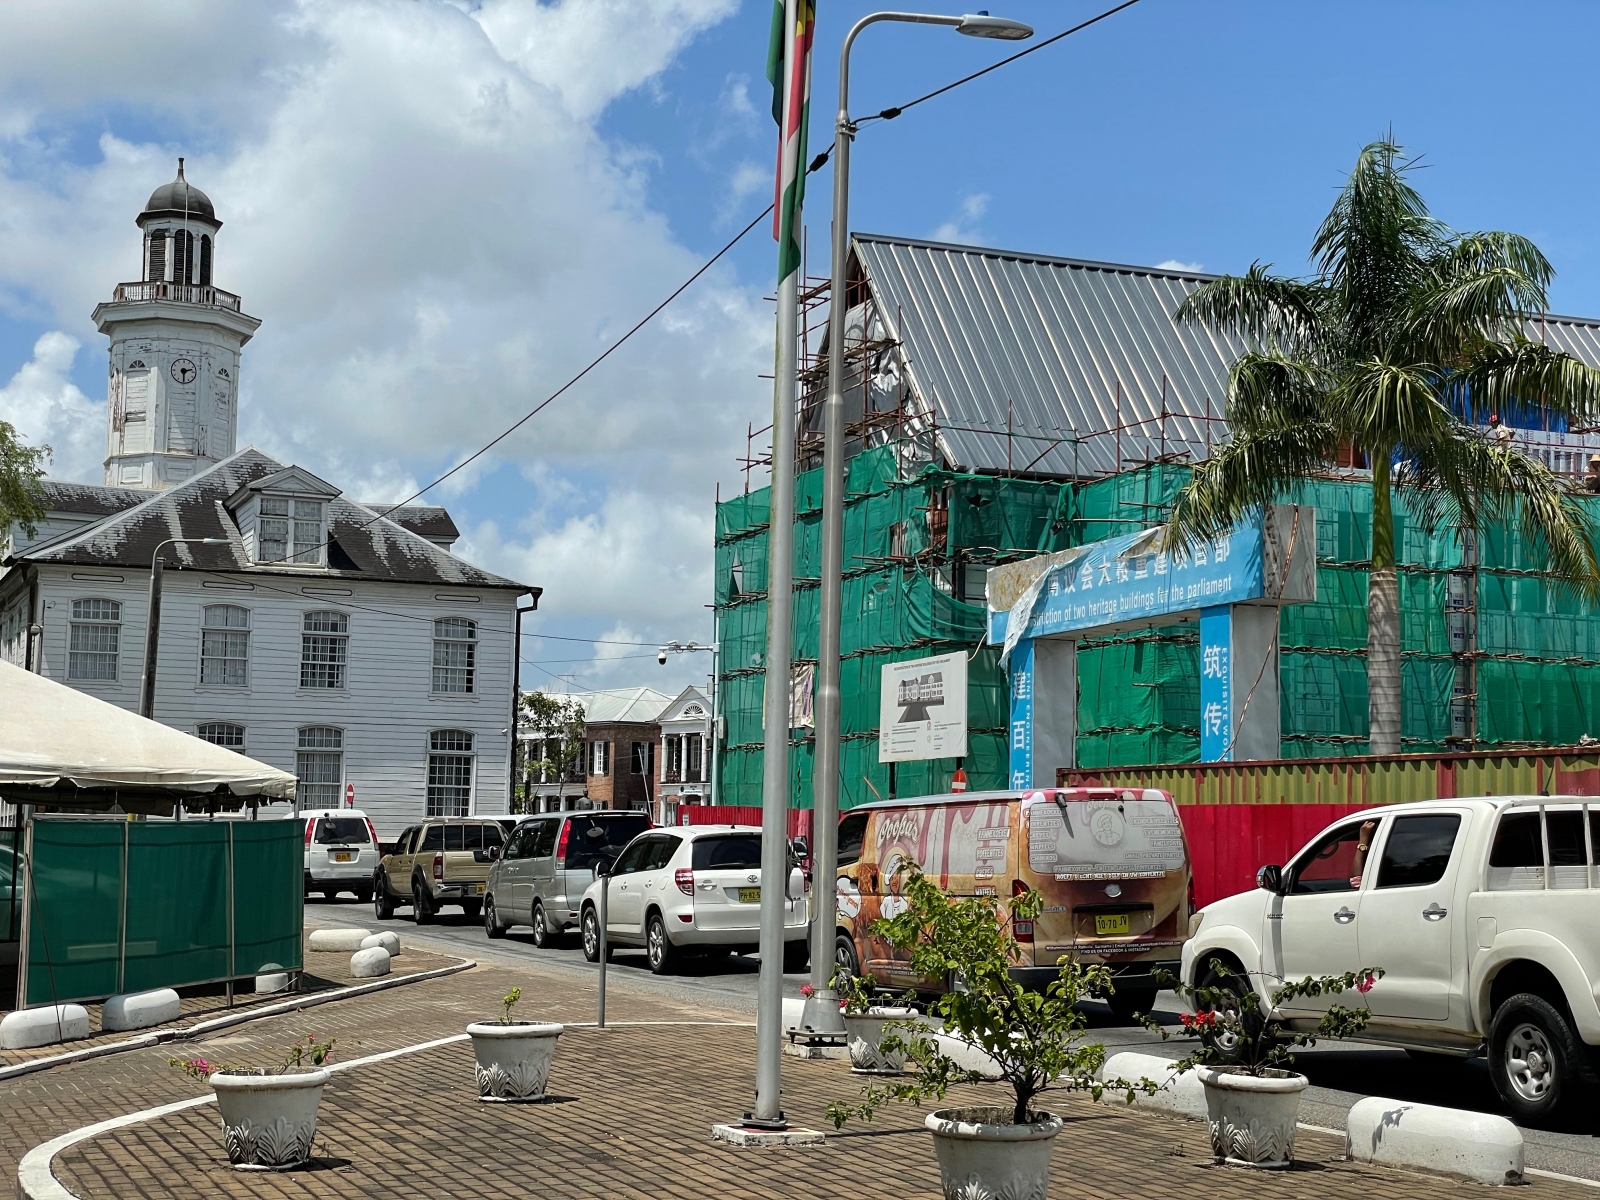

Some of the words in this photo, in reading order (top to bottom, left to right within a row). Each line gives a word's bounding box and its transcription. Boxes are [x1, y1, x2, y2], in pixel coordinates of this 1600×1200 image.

[1064, 605, 1072, 620] of
[1073, 606, 1086, 620] two
[1088, 598, 1118, 616] heritage
[1119, 590, 1154, 610] buildings
[1157, 587, 1169, 603] for
[1171, 584, 1184, 601] the
[1187, 573, 1232, 599] parliament
[1203, 645, 1222, 763] 筑传
[1098, 920, 1117, 929] 10-70
